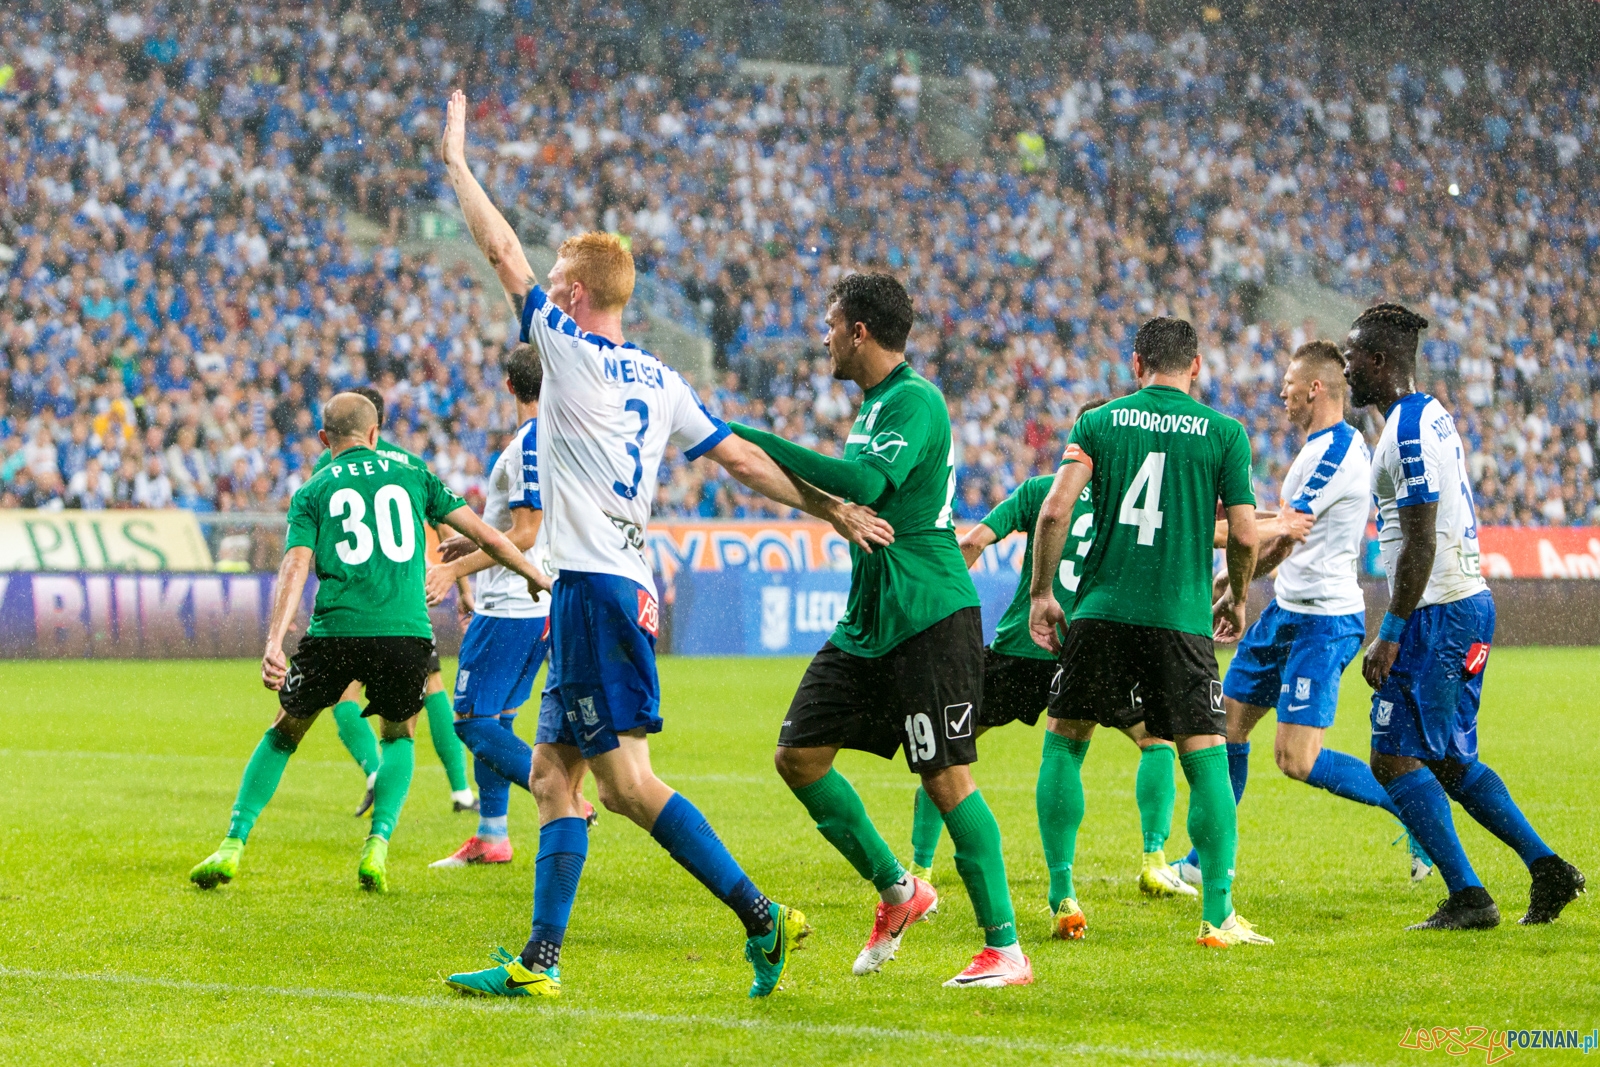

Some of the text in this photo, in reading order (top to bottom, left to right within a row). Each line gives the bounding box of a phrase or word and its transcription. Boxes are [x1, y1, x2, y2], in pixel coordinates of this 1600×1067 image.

[613, 398, 649, 500] 3
[1110, 408, 1209, 436] TODOROVSKI
[331, 460, 390, 478] PEEV
[1119, 451, 1166, 547] 4
[24, 519, 167, 569] PILS
[329, 484, 416, 565] 30
[32, 575, 280, 655] BUKM
[904, 712, 937, 763] 19
